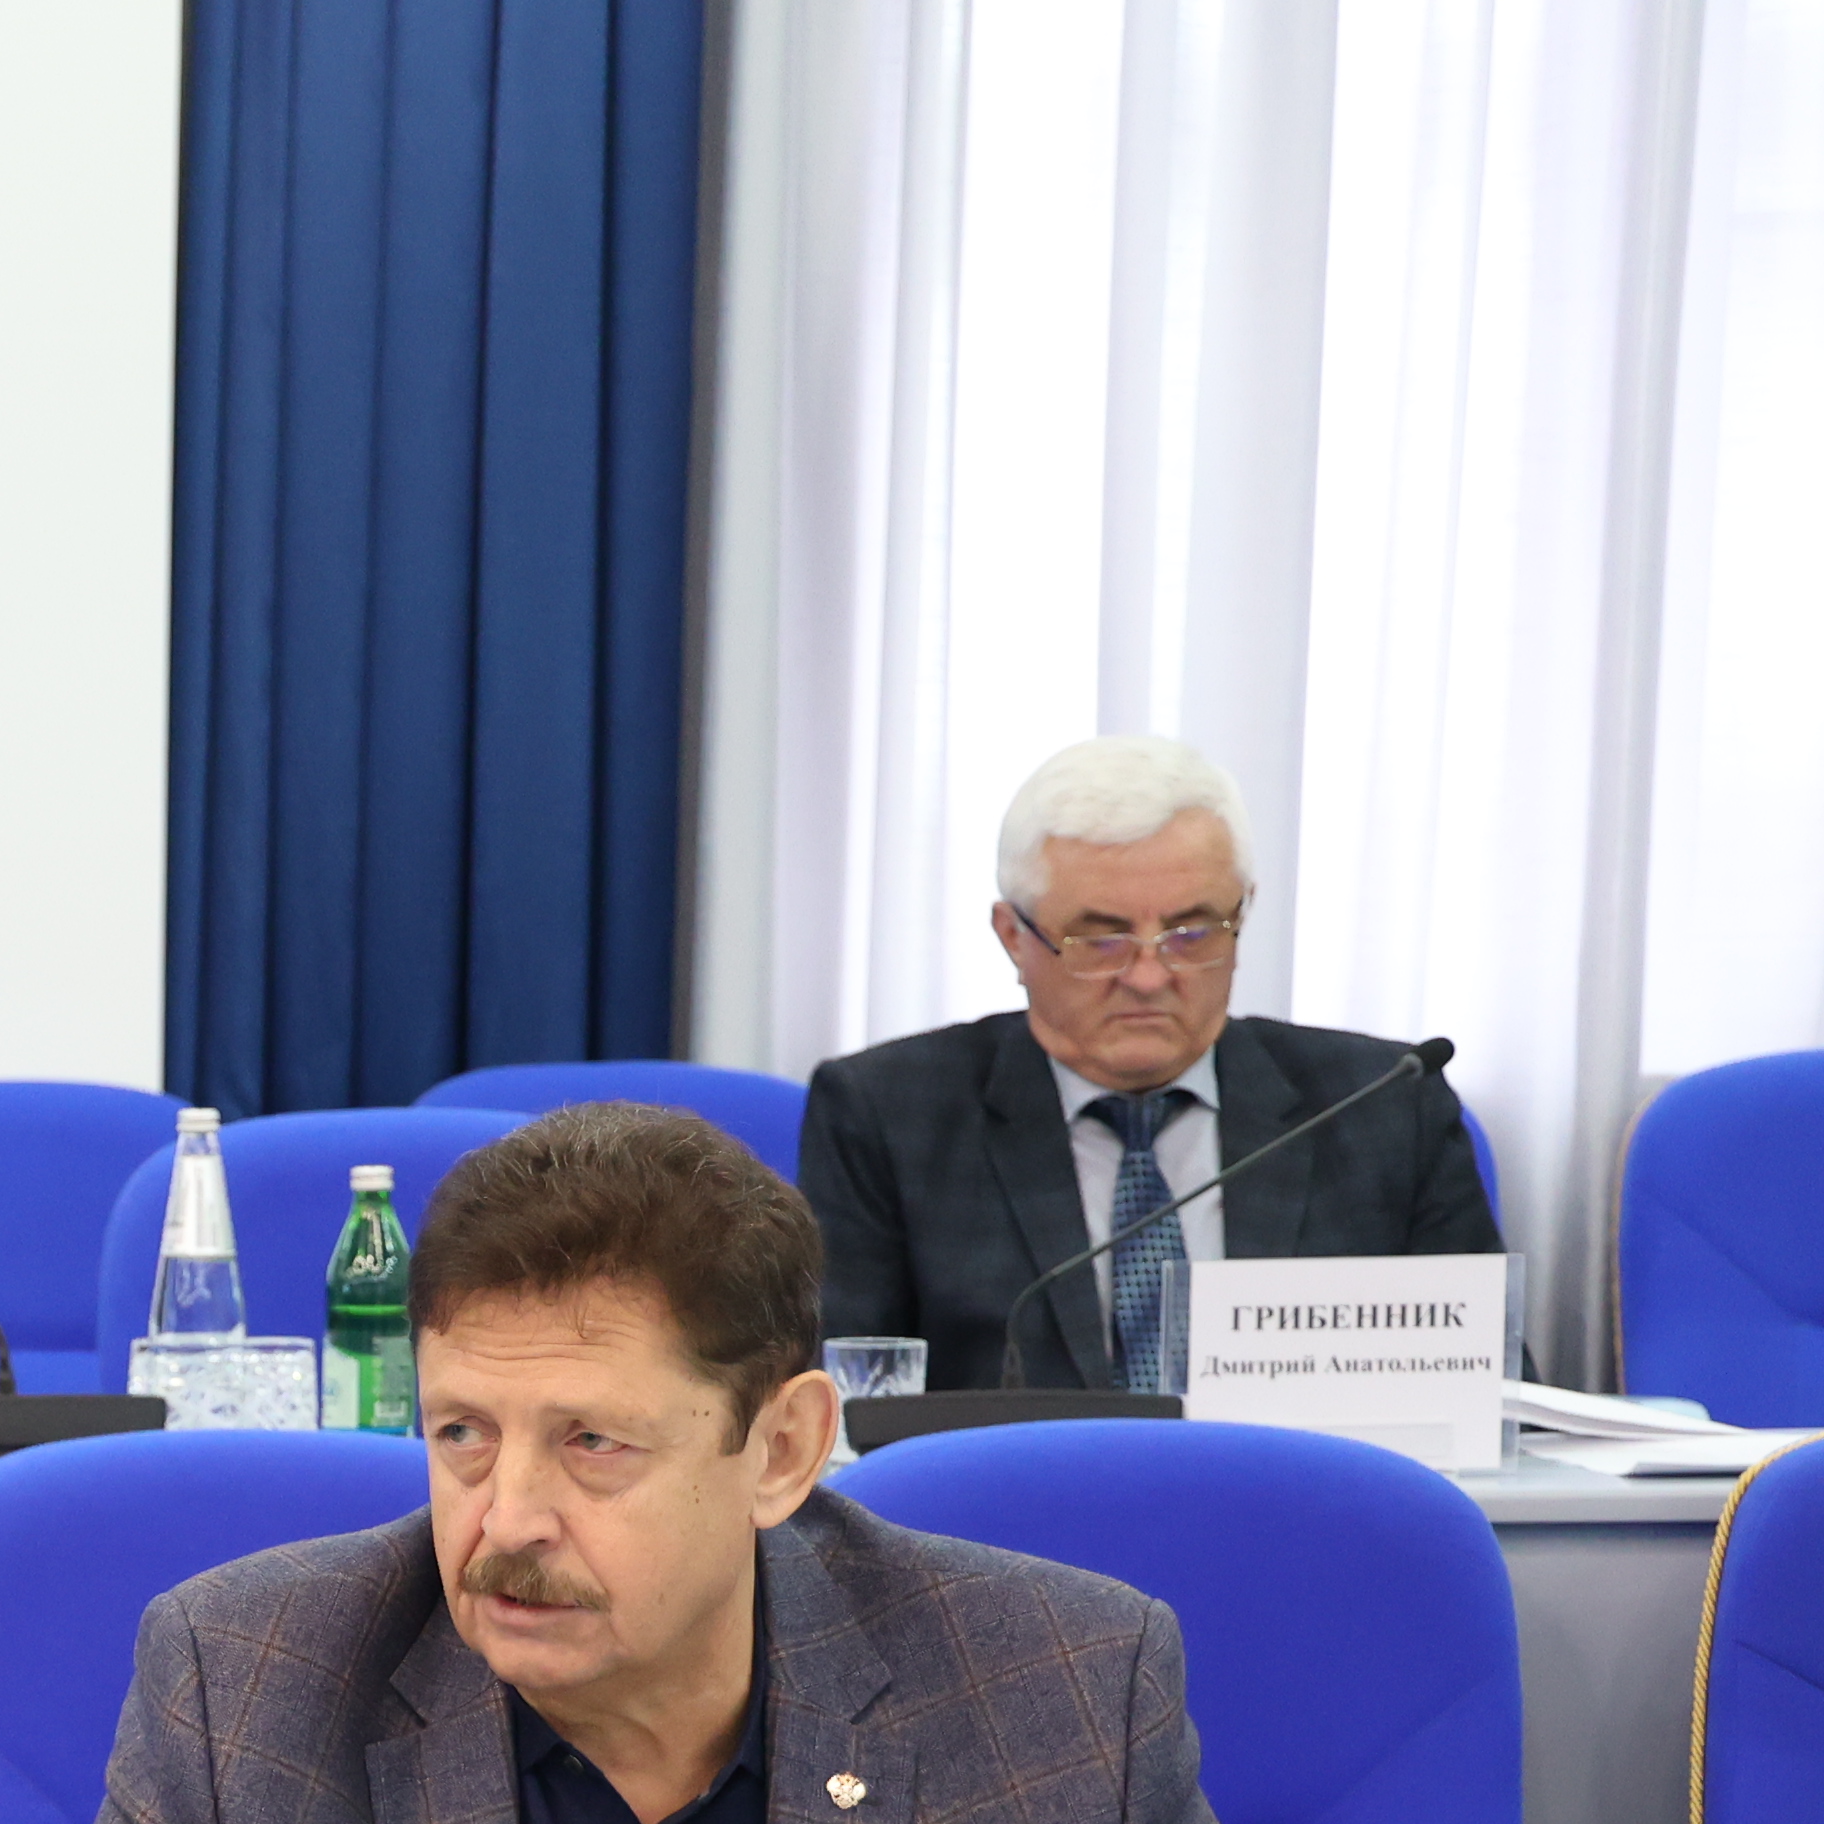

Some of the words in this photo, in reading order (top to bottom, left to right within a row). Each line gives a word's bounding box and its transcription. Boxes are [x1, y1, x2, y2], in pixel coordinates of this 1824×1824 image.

[1231, 1302, 1466, 1333] ГРИБЕННИК
[1199, 1353, 1317, 1379] Дмитрий
[1324, 1354, 1492, 1375] Анатольевич
